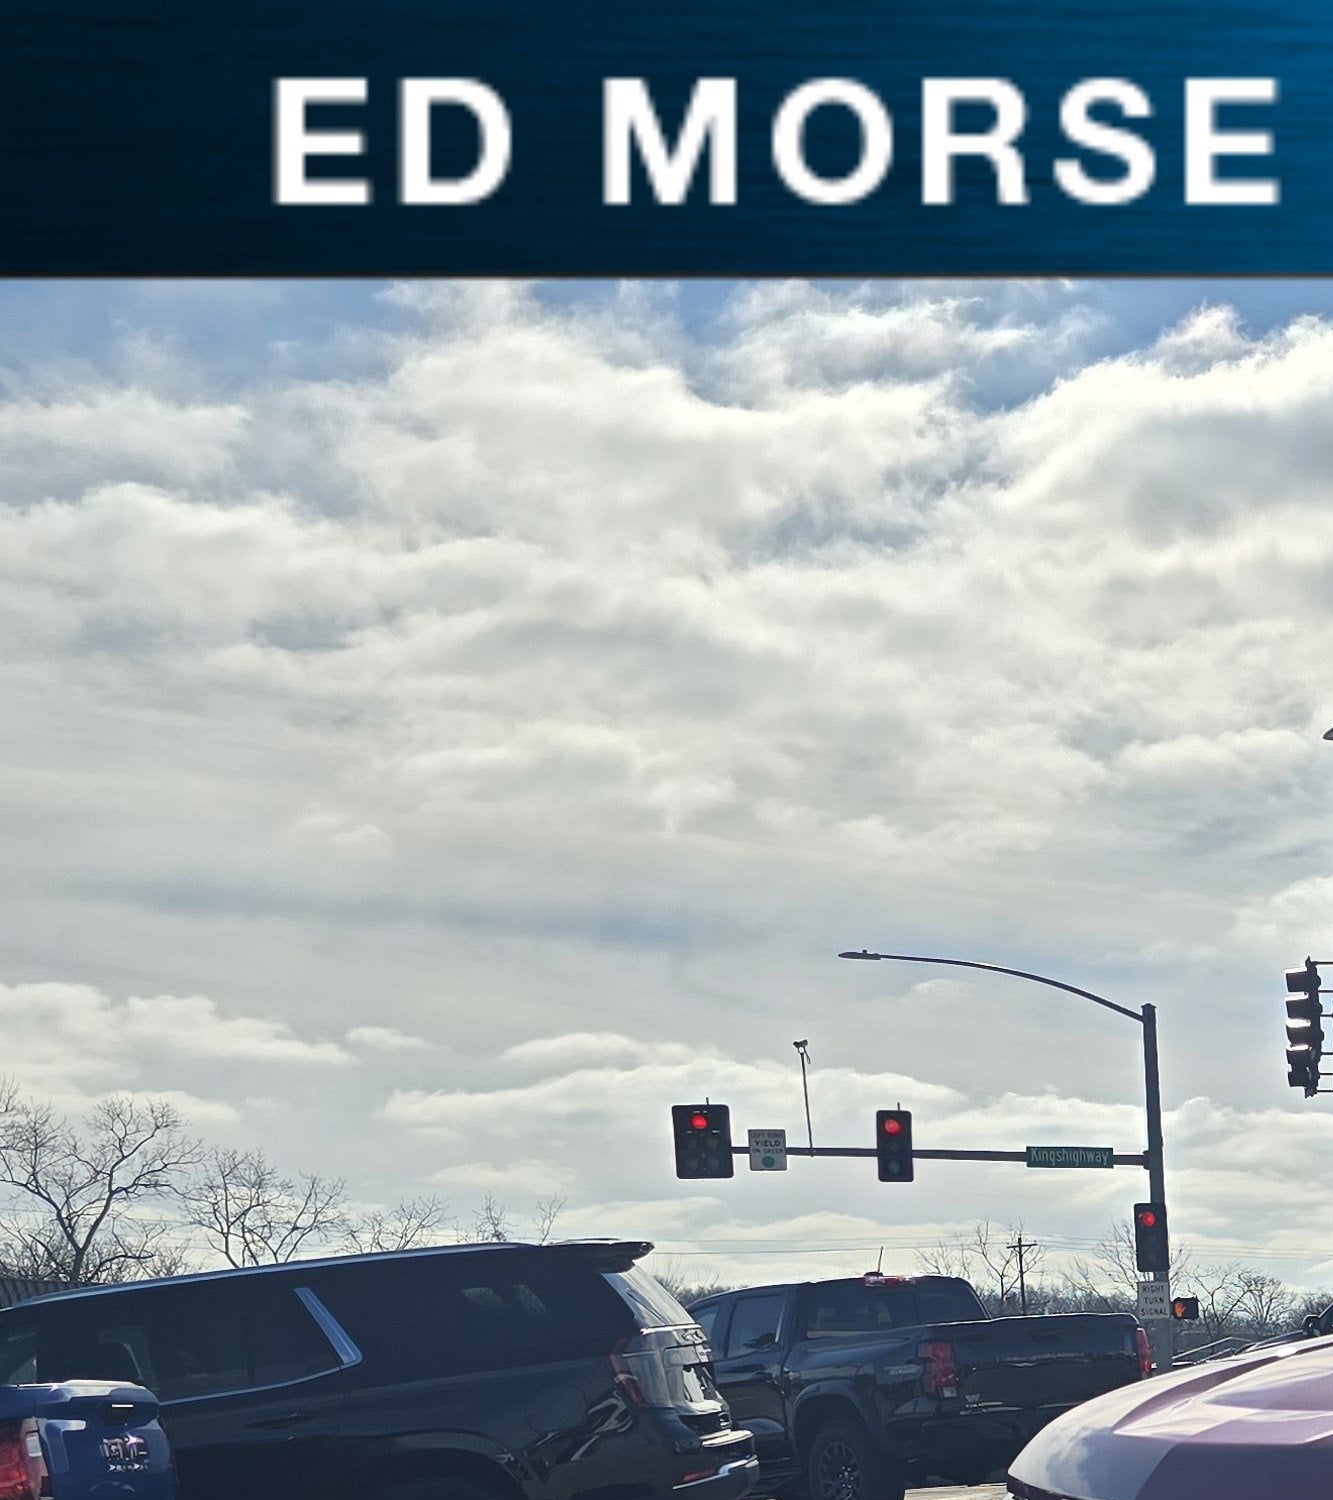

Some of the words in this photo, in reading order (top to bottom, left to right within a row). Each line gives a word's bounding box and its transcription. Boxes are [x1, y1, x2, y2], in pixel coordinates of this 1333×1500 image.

[1031, 1148, 1109, 1166] Kingshighway
[1142, 1285, 1164, 1293] RIGHT
[1141, 1308, 1168, 1316] SIGNAL
